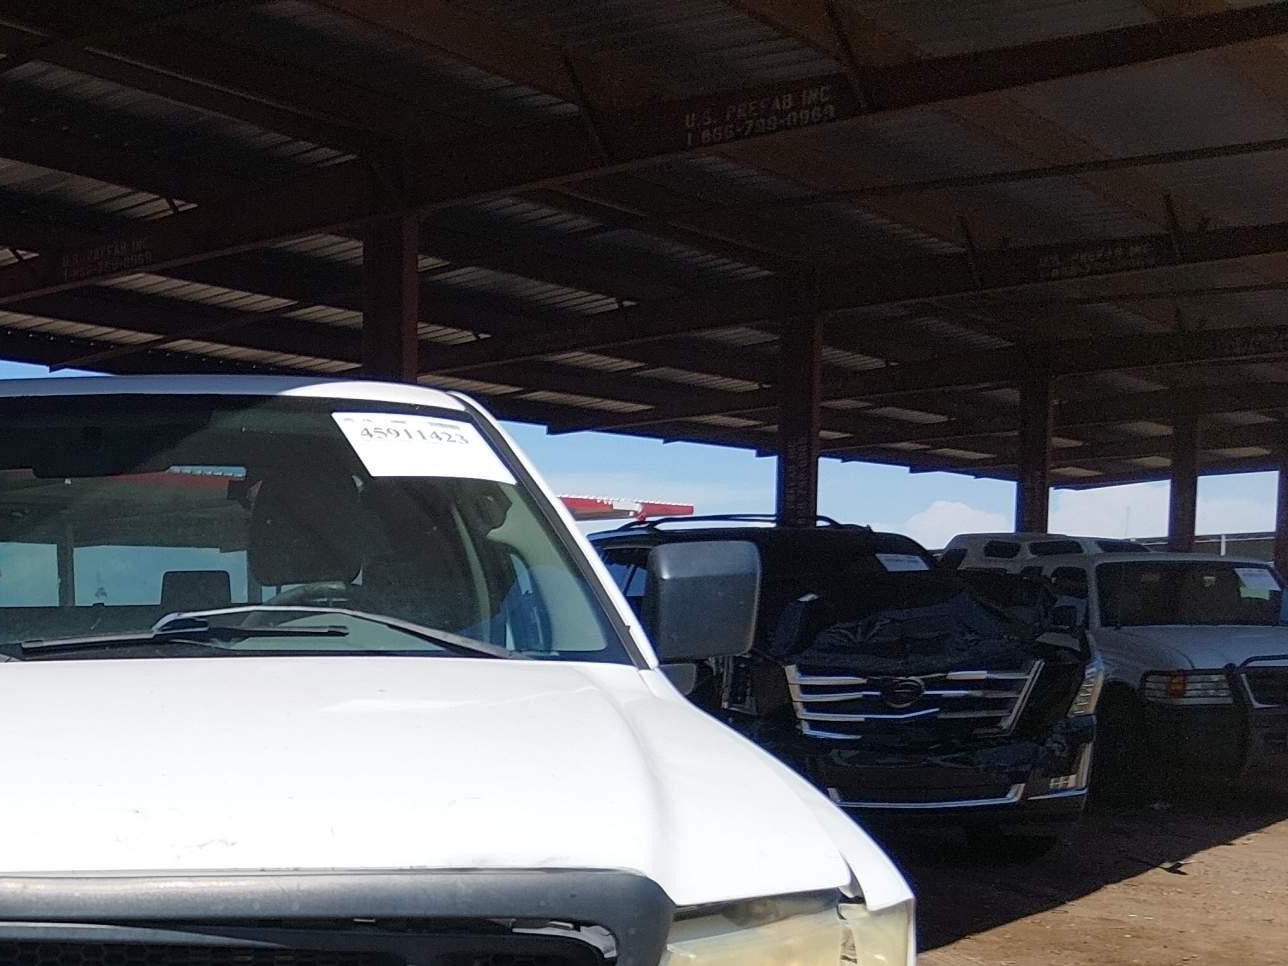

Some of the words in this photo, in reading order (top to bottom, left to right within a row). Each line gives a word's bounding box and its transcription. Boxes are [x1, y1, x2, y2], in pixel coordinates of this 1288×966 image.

[726, 93, 794, 121] PREFAB
[801, 85, 833, 105] INC
[360, 426, 469, 445] 45911423
